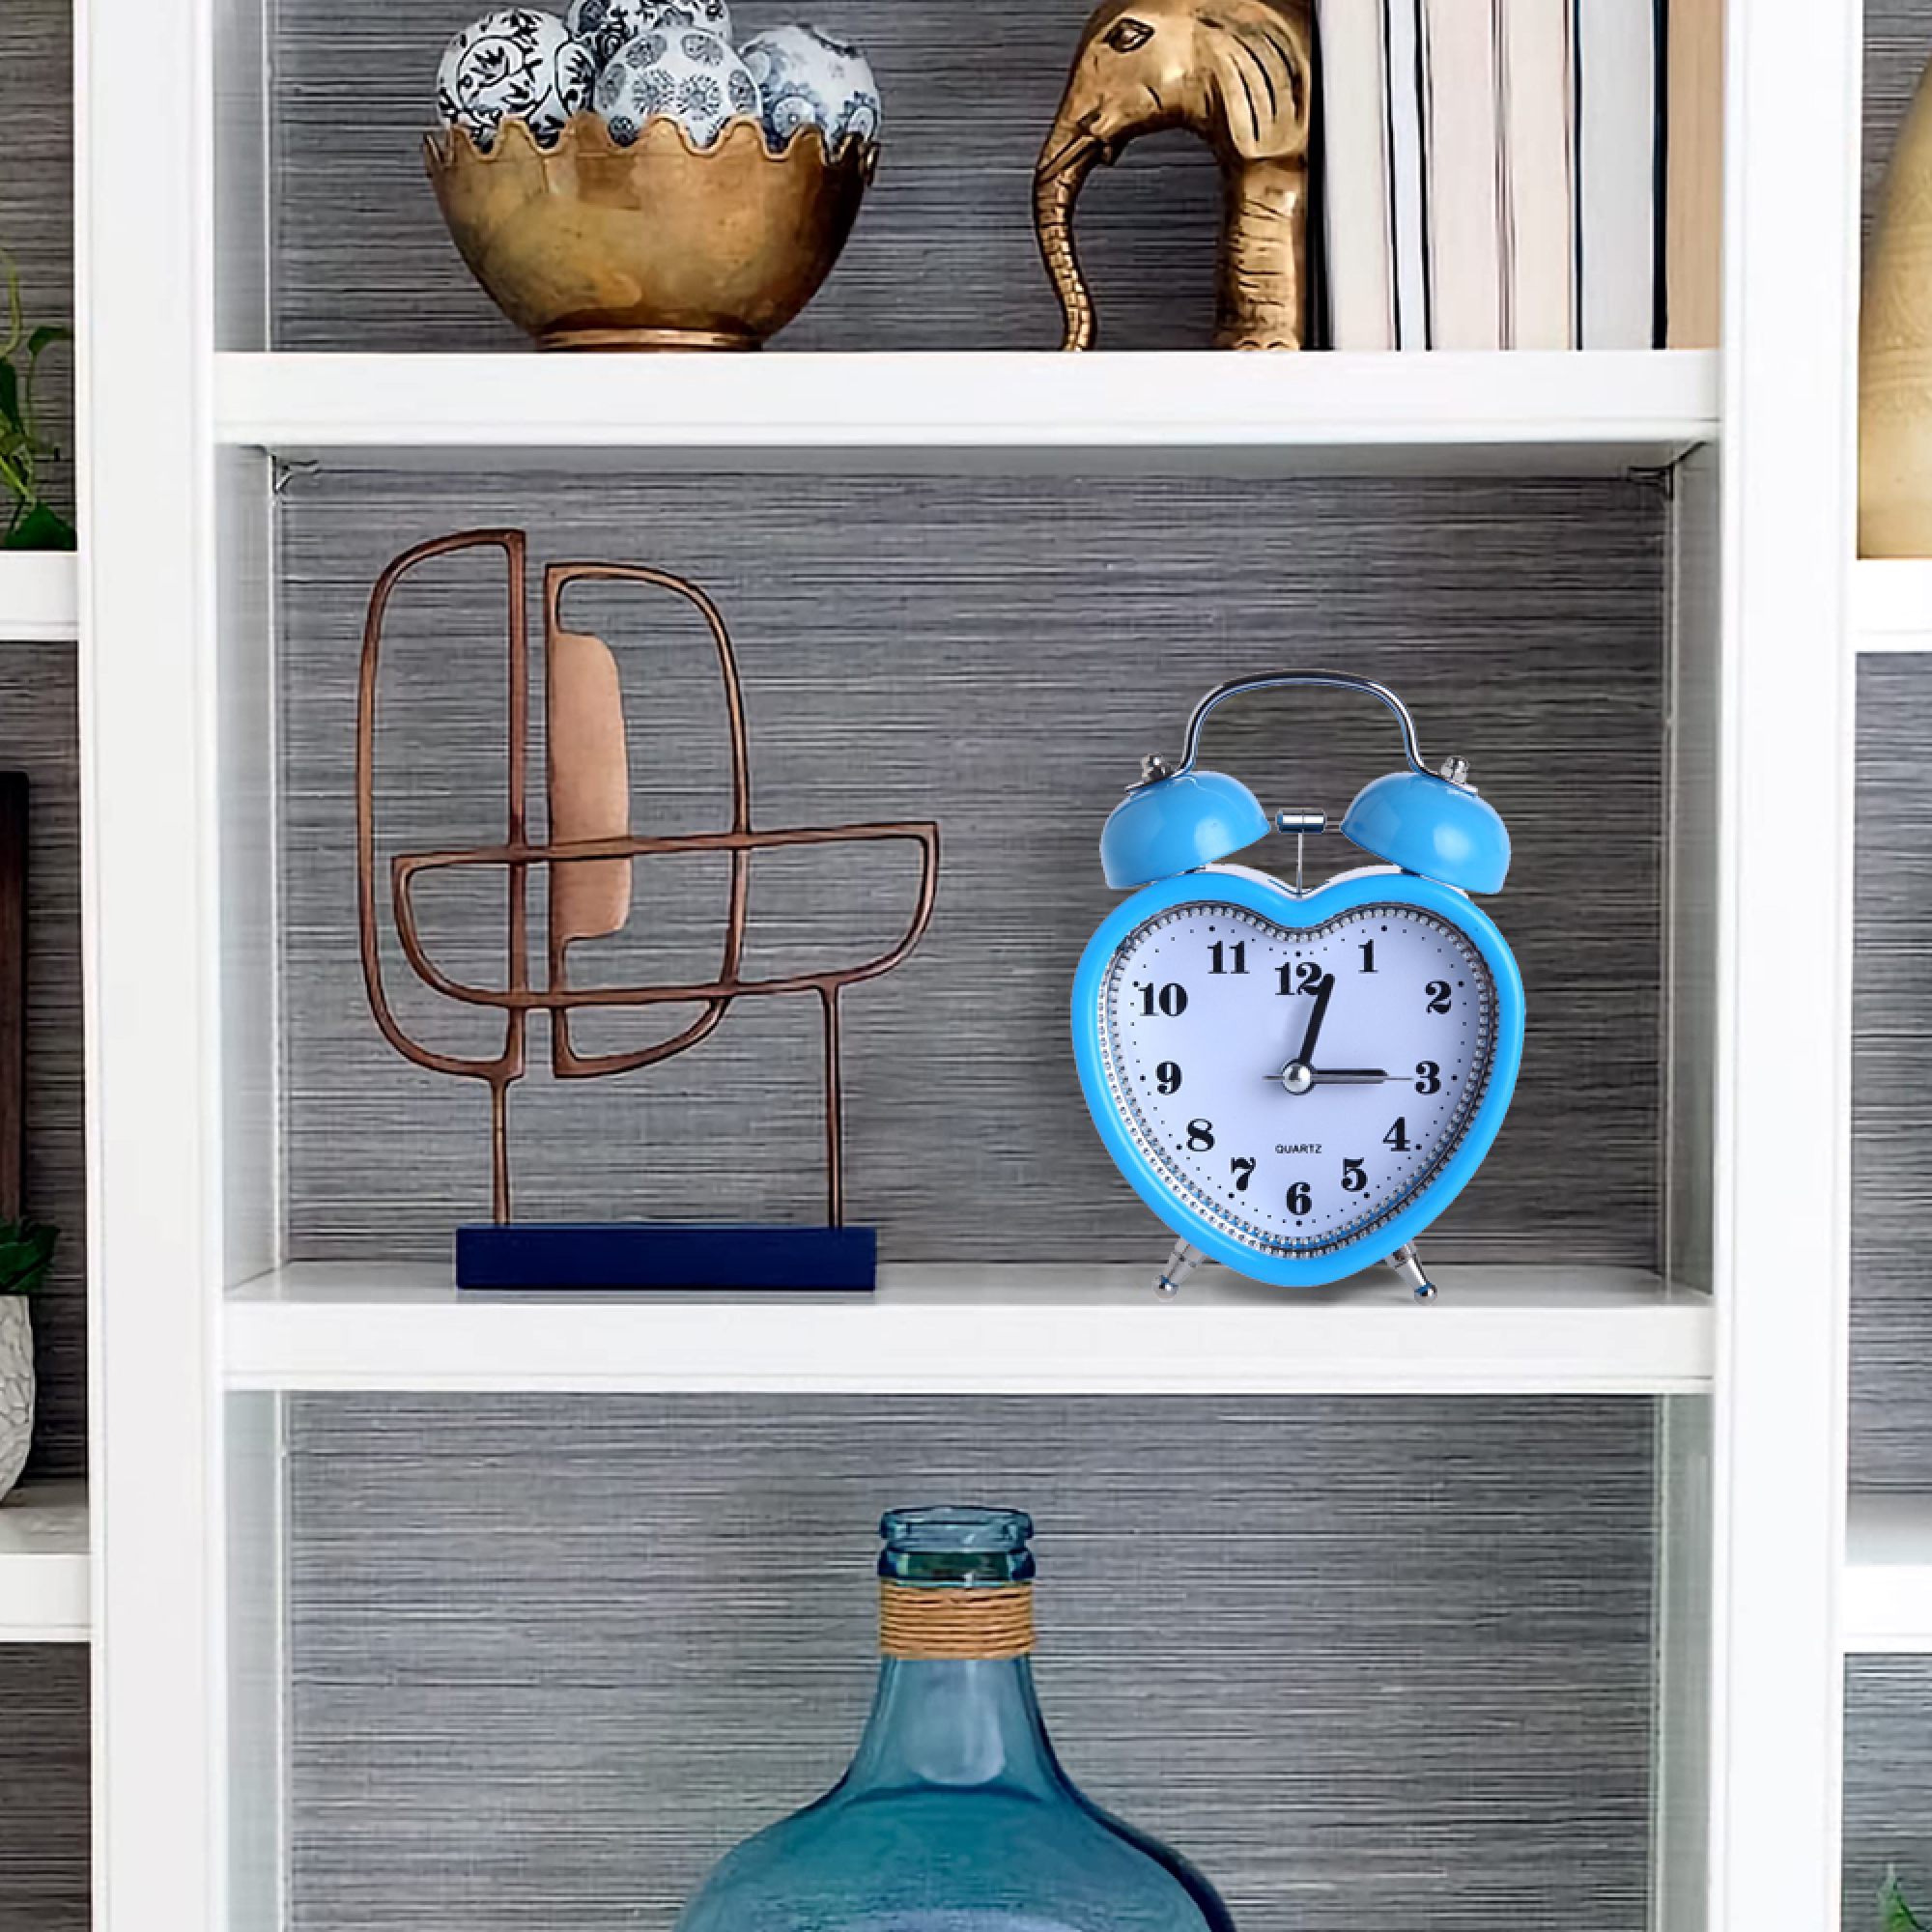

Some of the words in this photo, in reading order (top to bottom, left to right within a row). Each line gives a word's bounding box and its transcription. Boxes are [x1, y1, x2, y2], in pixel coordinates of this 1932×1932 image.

[1208, 940, 1250, 974] 11
[1358, 939, 1378, 972] 1
[1275, 962, 1323, 995] 12
[1138, 982, 1188, 1016] 10
[1425, 980, 1451, 1014] 2
[1156, 1061, 1182, 1094] 9
[1414, 1061, 1441, 1094] 3
[1187, 1119, 1215, 1151] 8
[1275, 1144, 1322, 1154] QUARTZ
[1382, 1117, 1410, 1151] 4
[1231, 1157, 1256, 1191] 7
[1341, 1157, 1367, 1191] 5
[1286, 1182, 1312, 1215] 6
